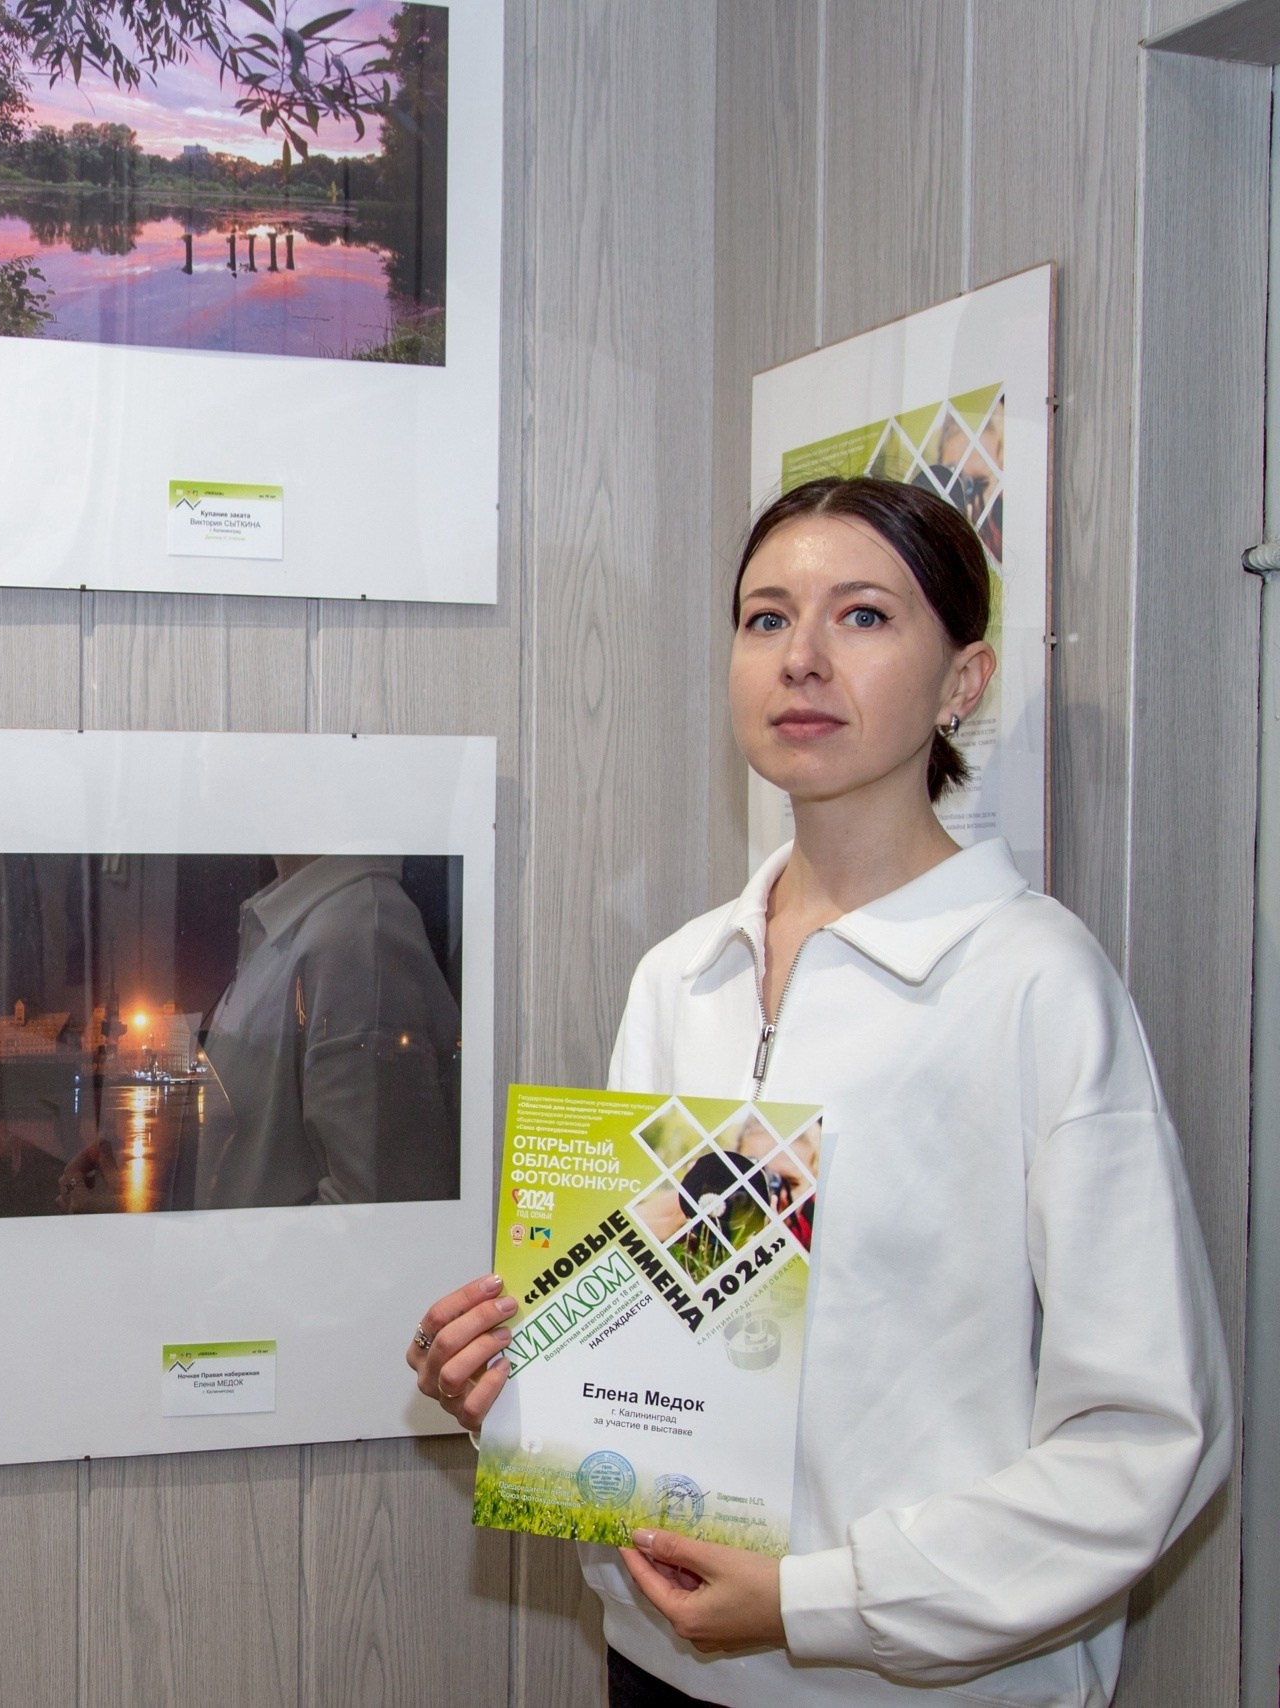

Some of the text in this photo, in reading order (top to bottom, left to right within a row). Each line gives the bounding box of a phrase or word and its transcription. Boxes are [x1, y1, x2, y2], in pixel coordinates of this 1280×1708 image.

[190, 518, 261, 528] Виктория СЫТКИНА
[200, 510, 228, 520] Купание
[513, 1135, 614, 1157] ОТКРЫТЫЙ
[512, 1152, 620, 1174] ОБЛАСТНОЙ
[511, 1169, 641, 1193] ФОТОКОНКУРС
[517, 1188, 555, 1211] 2024
[524, 1209, 631, 1304] «НОВЫЕ
[618, 1229, 704, 1333] ИМЕНА
[702, 1237, 786, 1312] 2024»
[543, 1281, 640, 1362] Возрастная категория от 18 лет
[579, 1314, 614, 1345] номинация
[588, 1294, 653, 1349] НАГРАЖДАЕТСЯ
[217, 1379, 244, 1387] МЕДОК
[582, 1382, 705, 1412] Елена Медок
[593, 1417, 604, 1425] за
[605, 1418, 641, 1430] участие
[650, 1425, 693, 1437] выставке
[619, 1408, 677, 1424] Калининград
